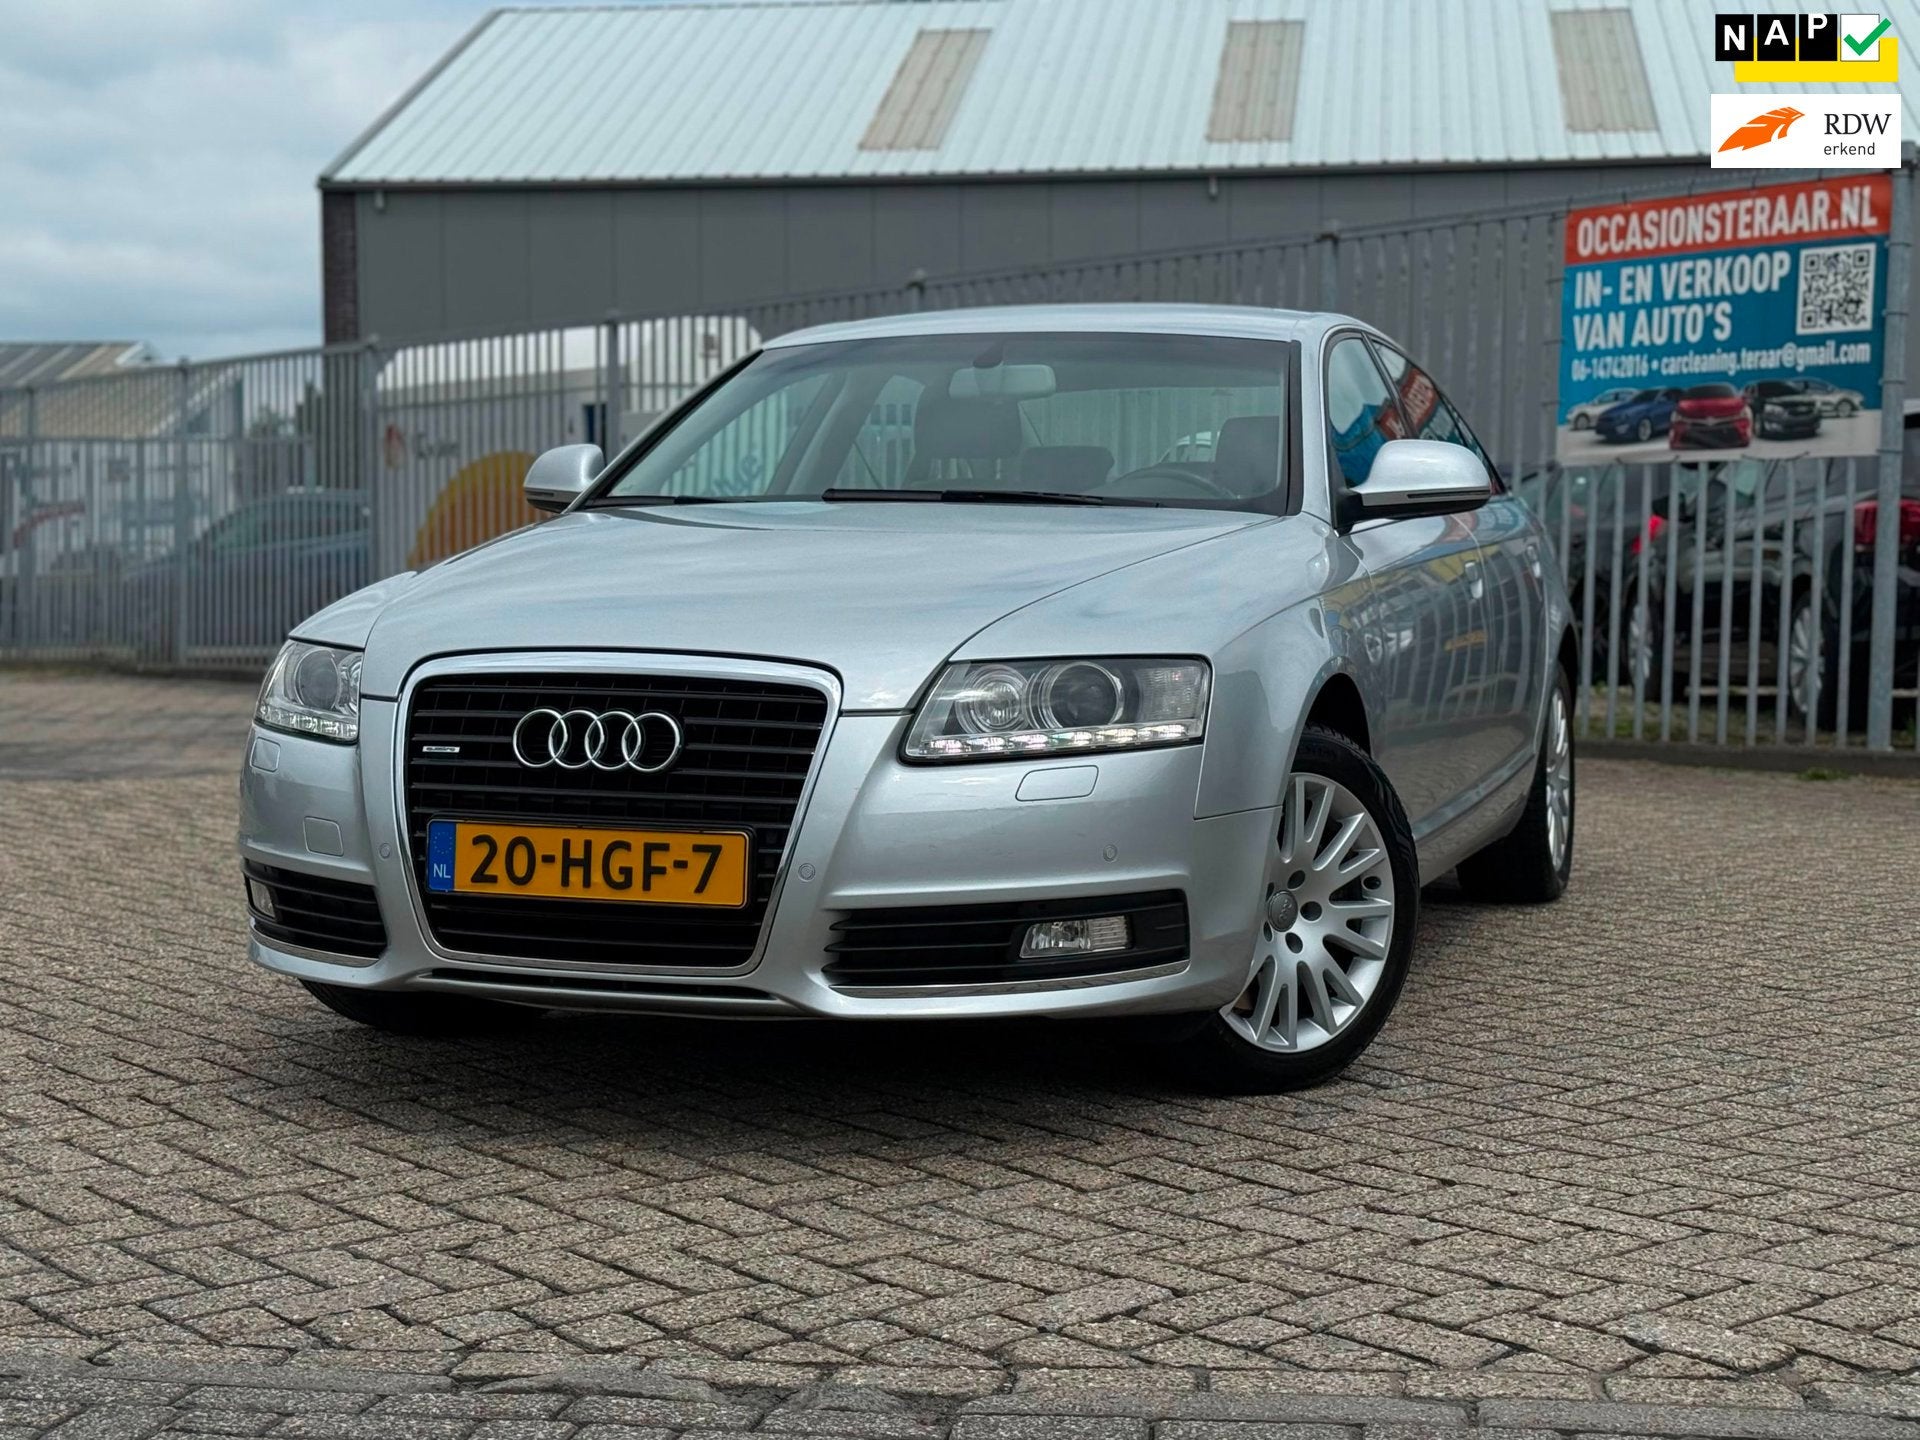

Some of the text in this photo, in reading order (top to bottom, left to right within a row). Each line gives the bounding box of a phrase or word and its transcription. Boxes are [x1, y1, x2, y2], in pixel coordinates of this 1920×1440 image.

[1577, 186, 1877, 257] OCCASIONSTERAAR.NL
[1574, 251, 1791, 309] IN- EN VERKOOP
[1573, 302, 1732, 352] VAN AUTO'S
[1661, 341, 1871, 376] carcleaning.teraar@gmail.com
[432, 863, 452, 880] NL
[470, 833, 723, 895] 20-HGF-7
